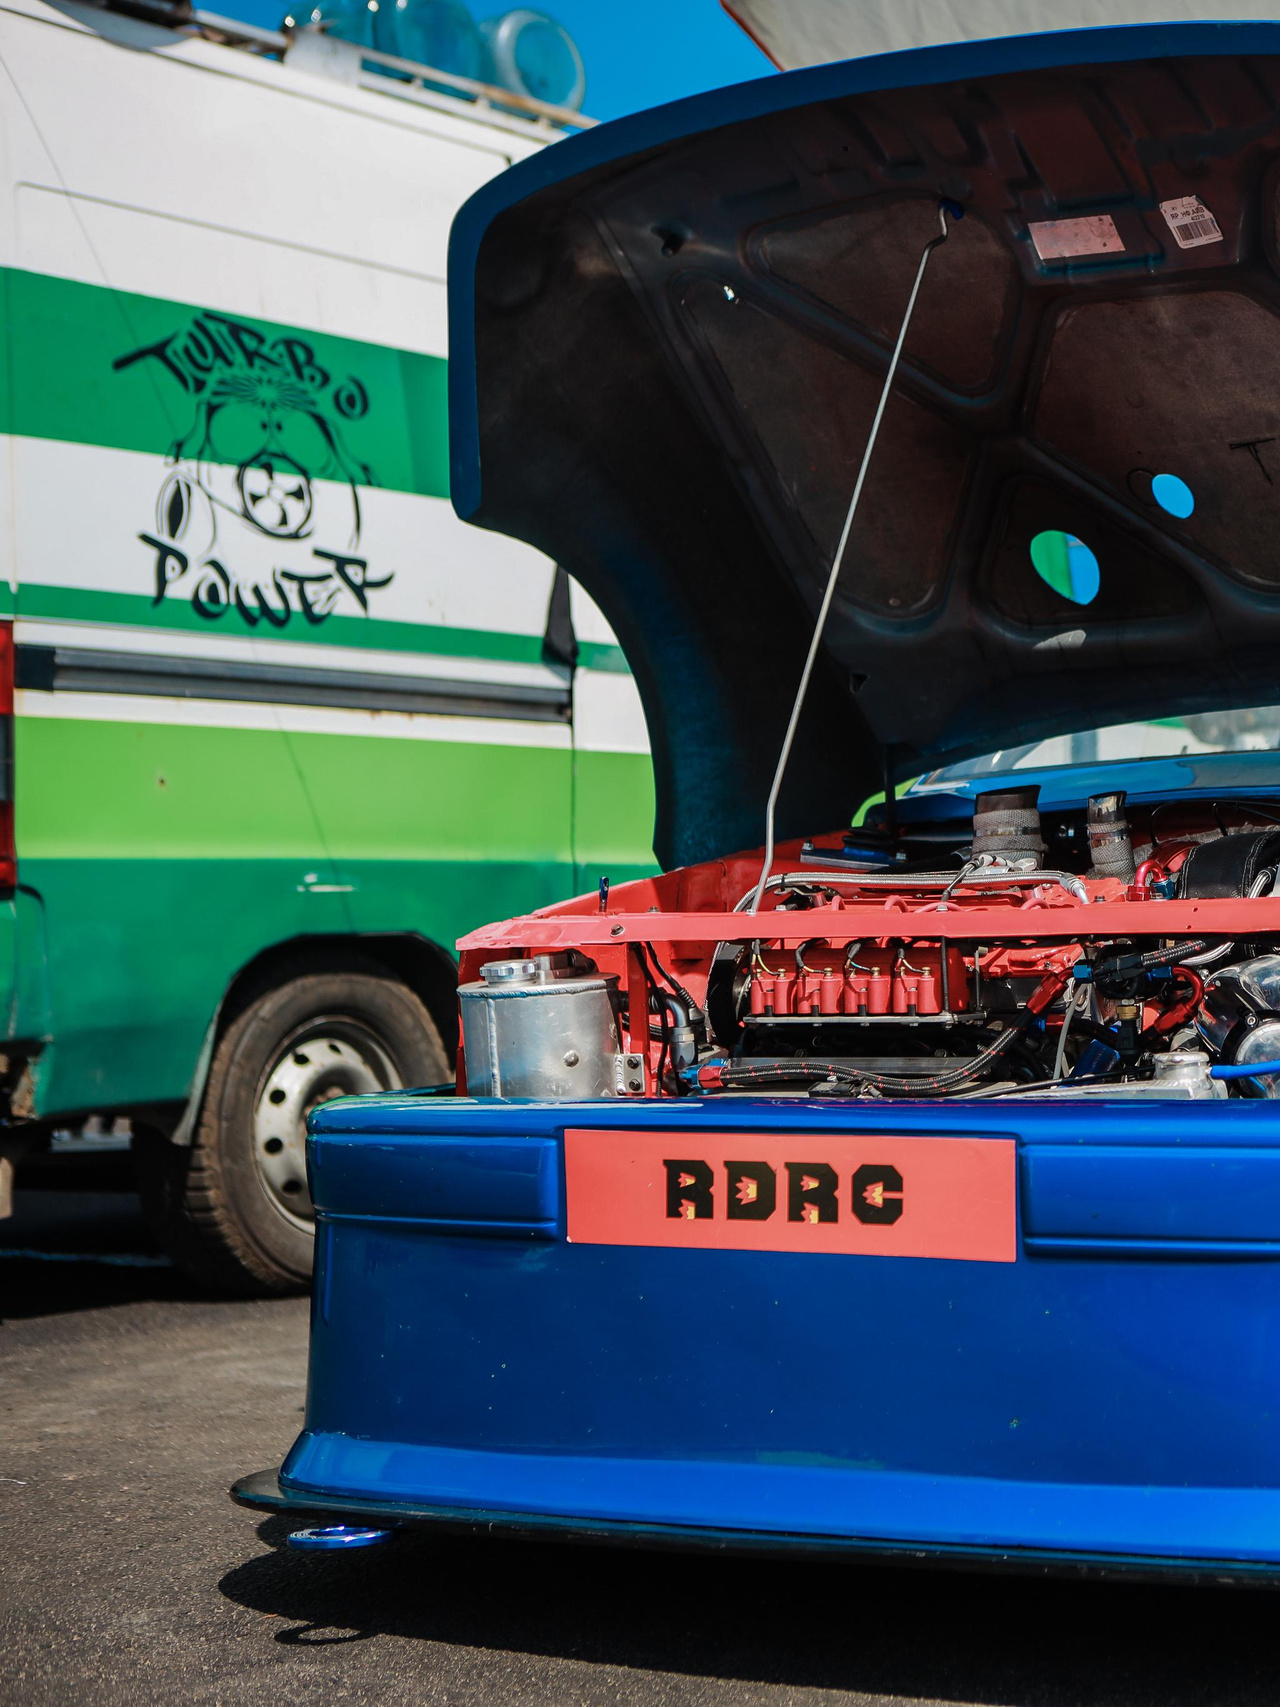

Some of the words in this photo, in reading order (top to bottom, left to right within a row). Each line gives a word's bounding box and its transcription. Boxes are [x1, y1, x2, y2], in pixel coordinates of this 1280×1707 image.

[113, 312, 369, 420] TURBO
[138, 530, 394, 627] POWER
[662, 1158, 904, 1226] RDRC
